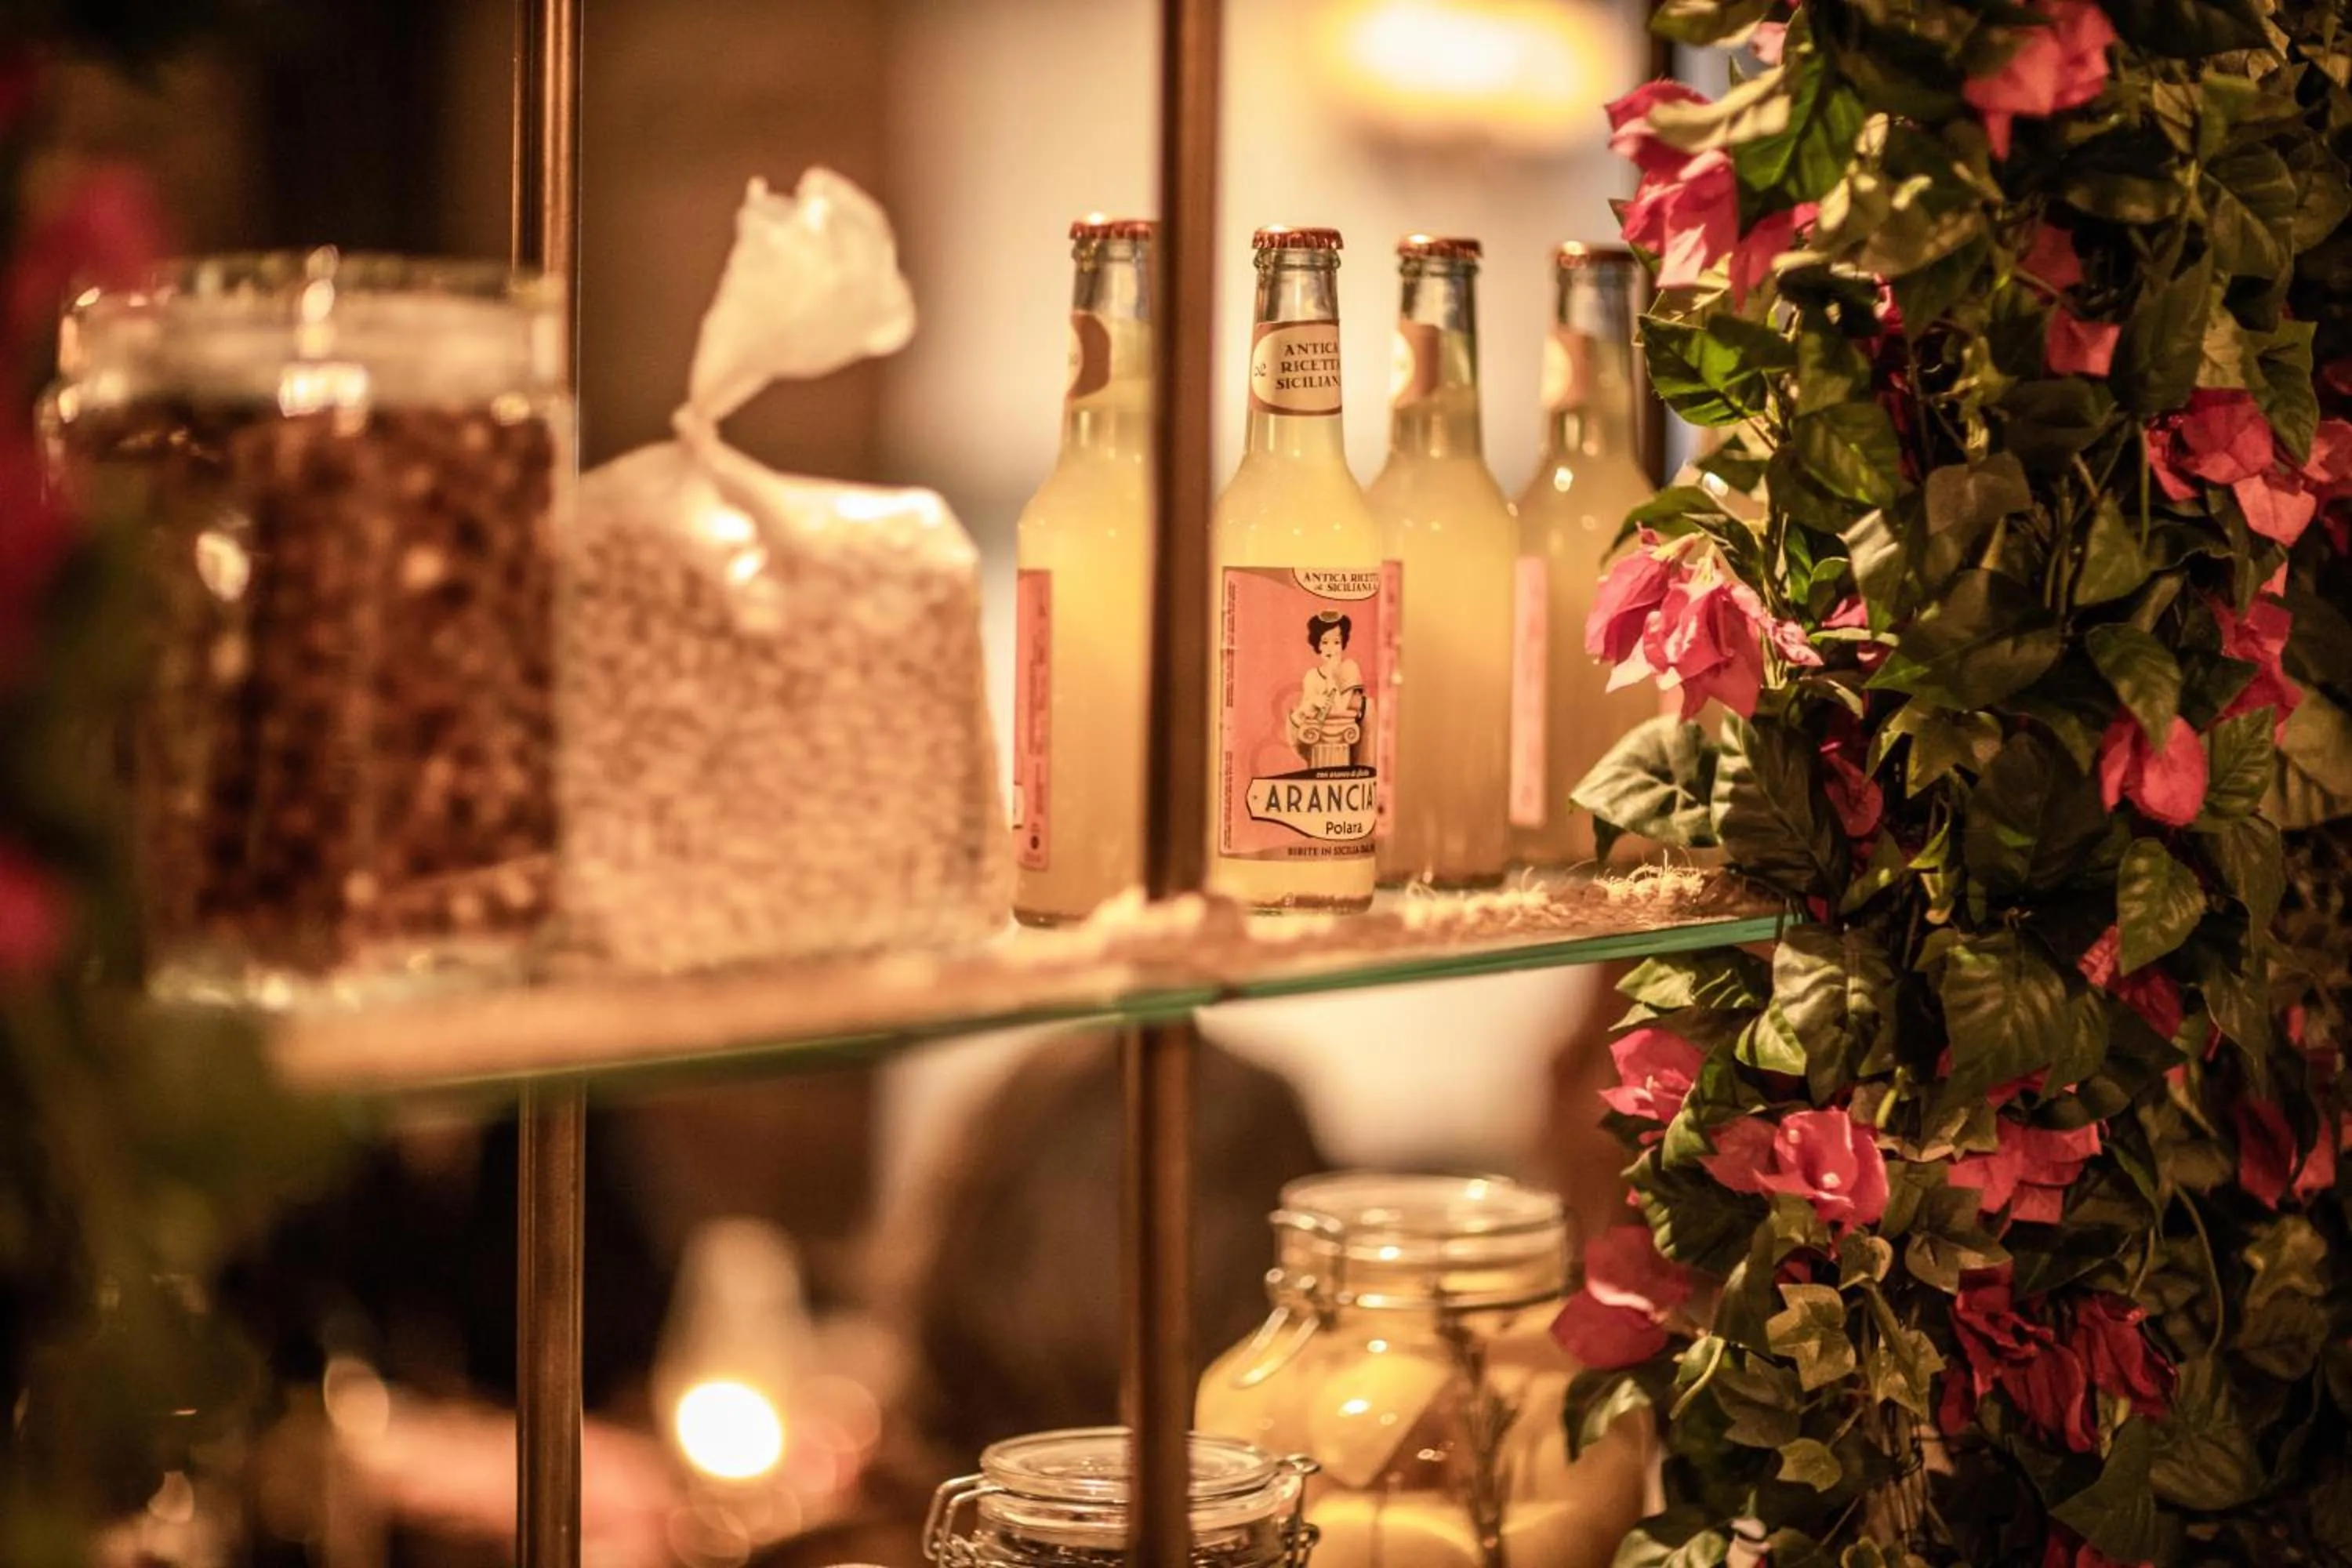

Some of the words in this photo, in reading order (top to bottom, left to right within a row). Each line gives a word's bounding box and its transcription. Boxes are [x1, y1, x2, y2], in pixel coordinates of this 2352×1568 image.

[1305, 572, 1347, 582] ANTICA
[1326, 822, 1362, 834] Polara
[1321, 846, 1332, 855] IN
